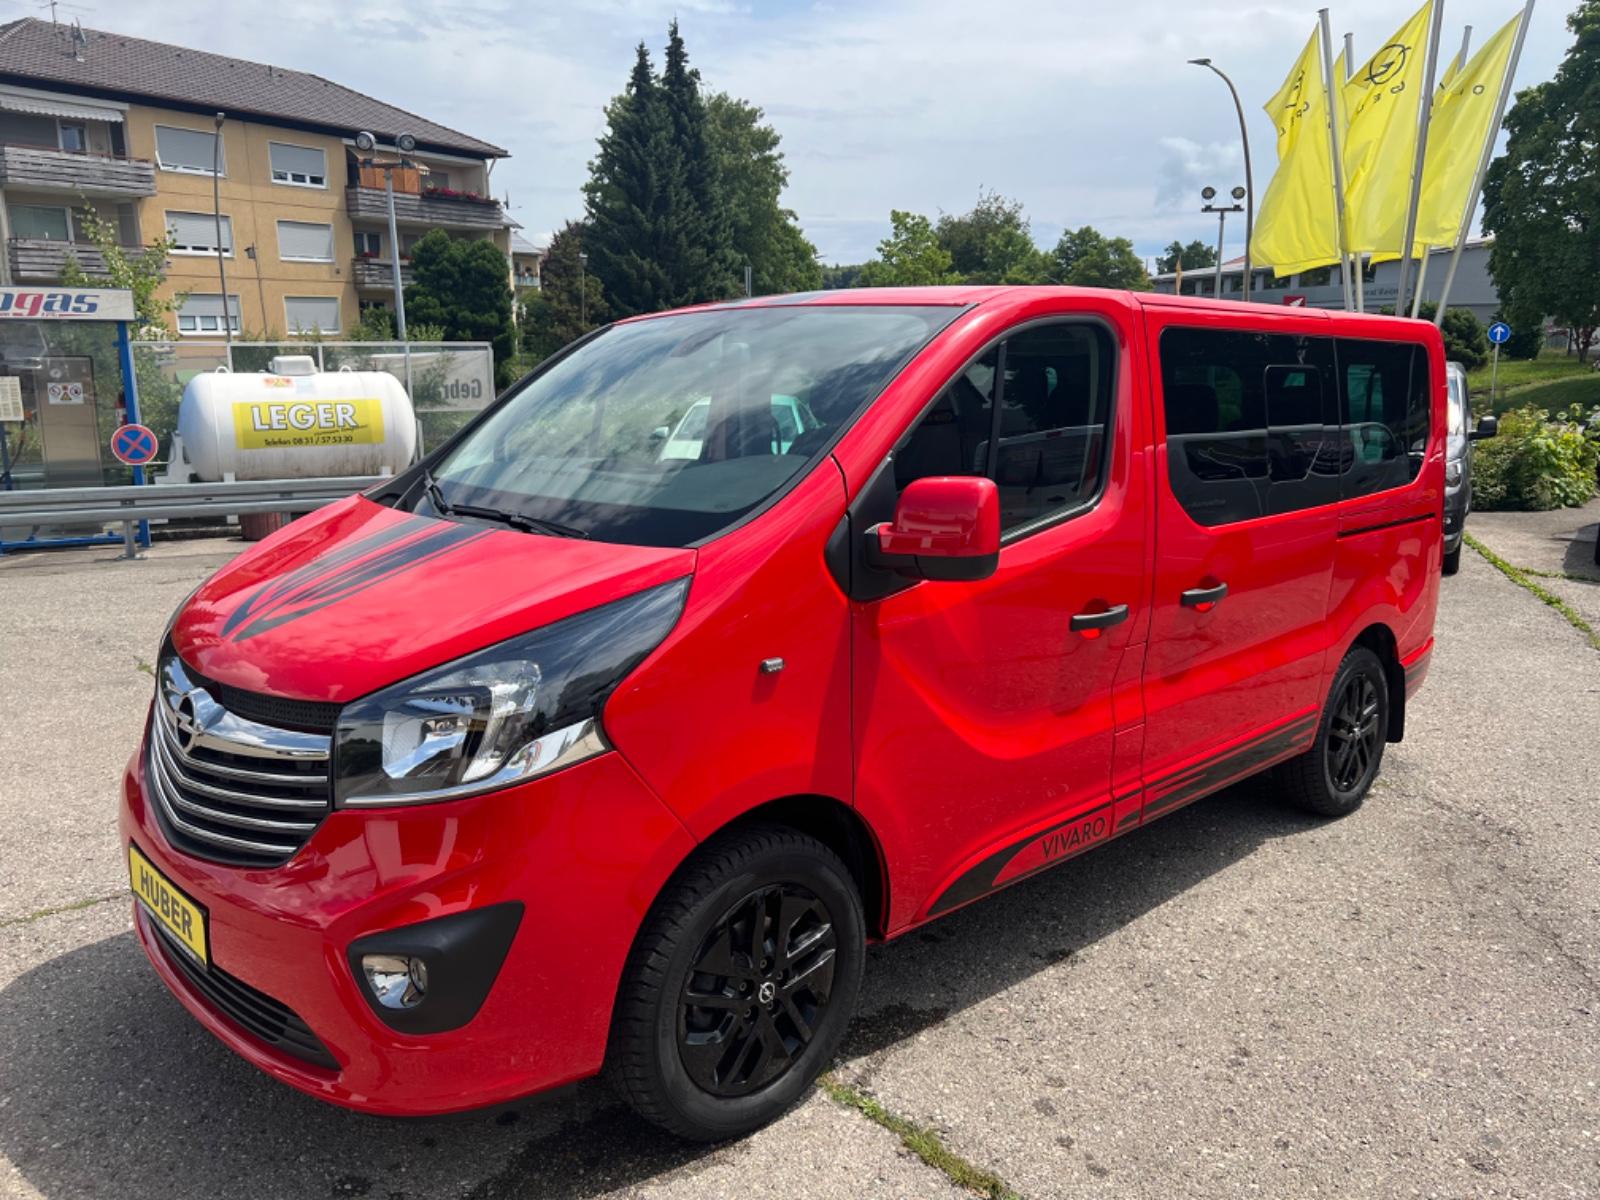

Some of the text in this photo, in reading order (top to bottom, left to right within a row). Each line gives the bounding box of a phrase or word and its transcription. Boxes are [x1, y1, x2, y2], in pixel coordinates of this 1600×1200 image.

[252, 402, 358, 431] LEGER
[1042, 816, 1106, 858] VIVARO
[140, 865, 193, 942] HUBER
